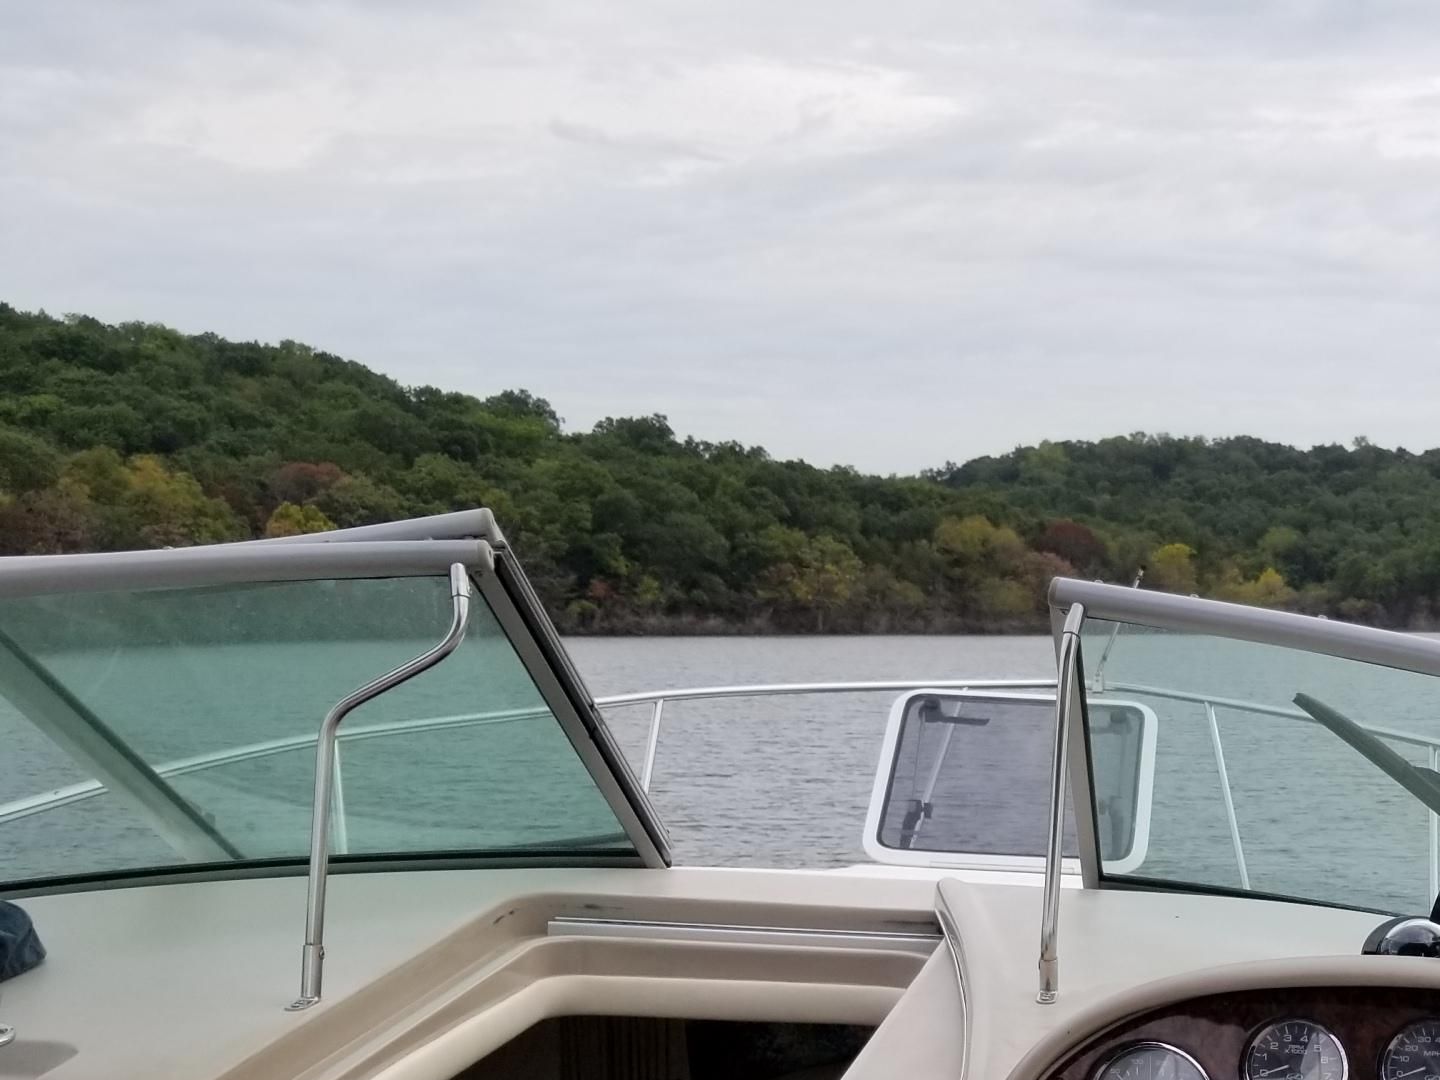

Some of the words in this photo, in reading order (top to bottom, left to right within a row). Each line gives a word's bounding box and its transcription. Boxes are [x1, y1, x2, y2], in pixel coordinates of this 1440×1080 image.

[1284, 1034, 1292, 1042] 3
[1300, 1035, 1308, 1043] 4
[1270, 1041, 1279, 1050] 2
